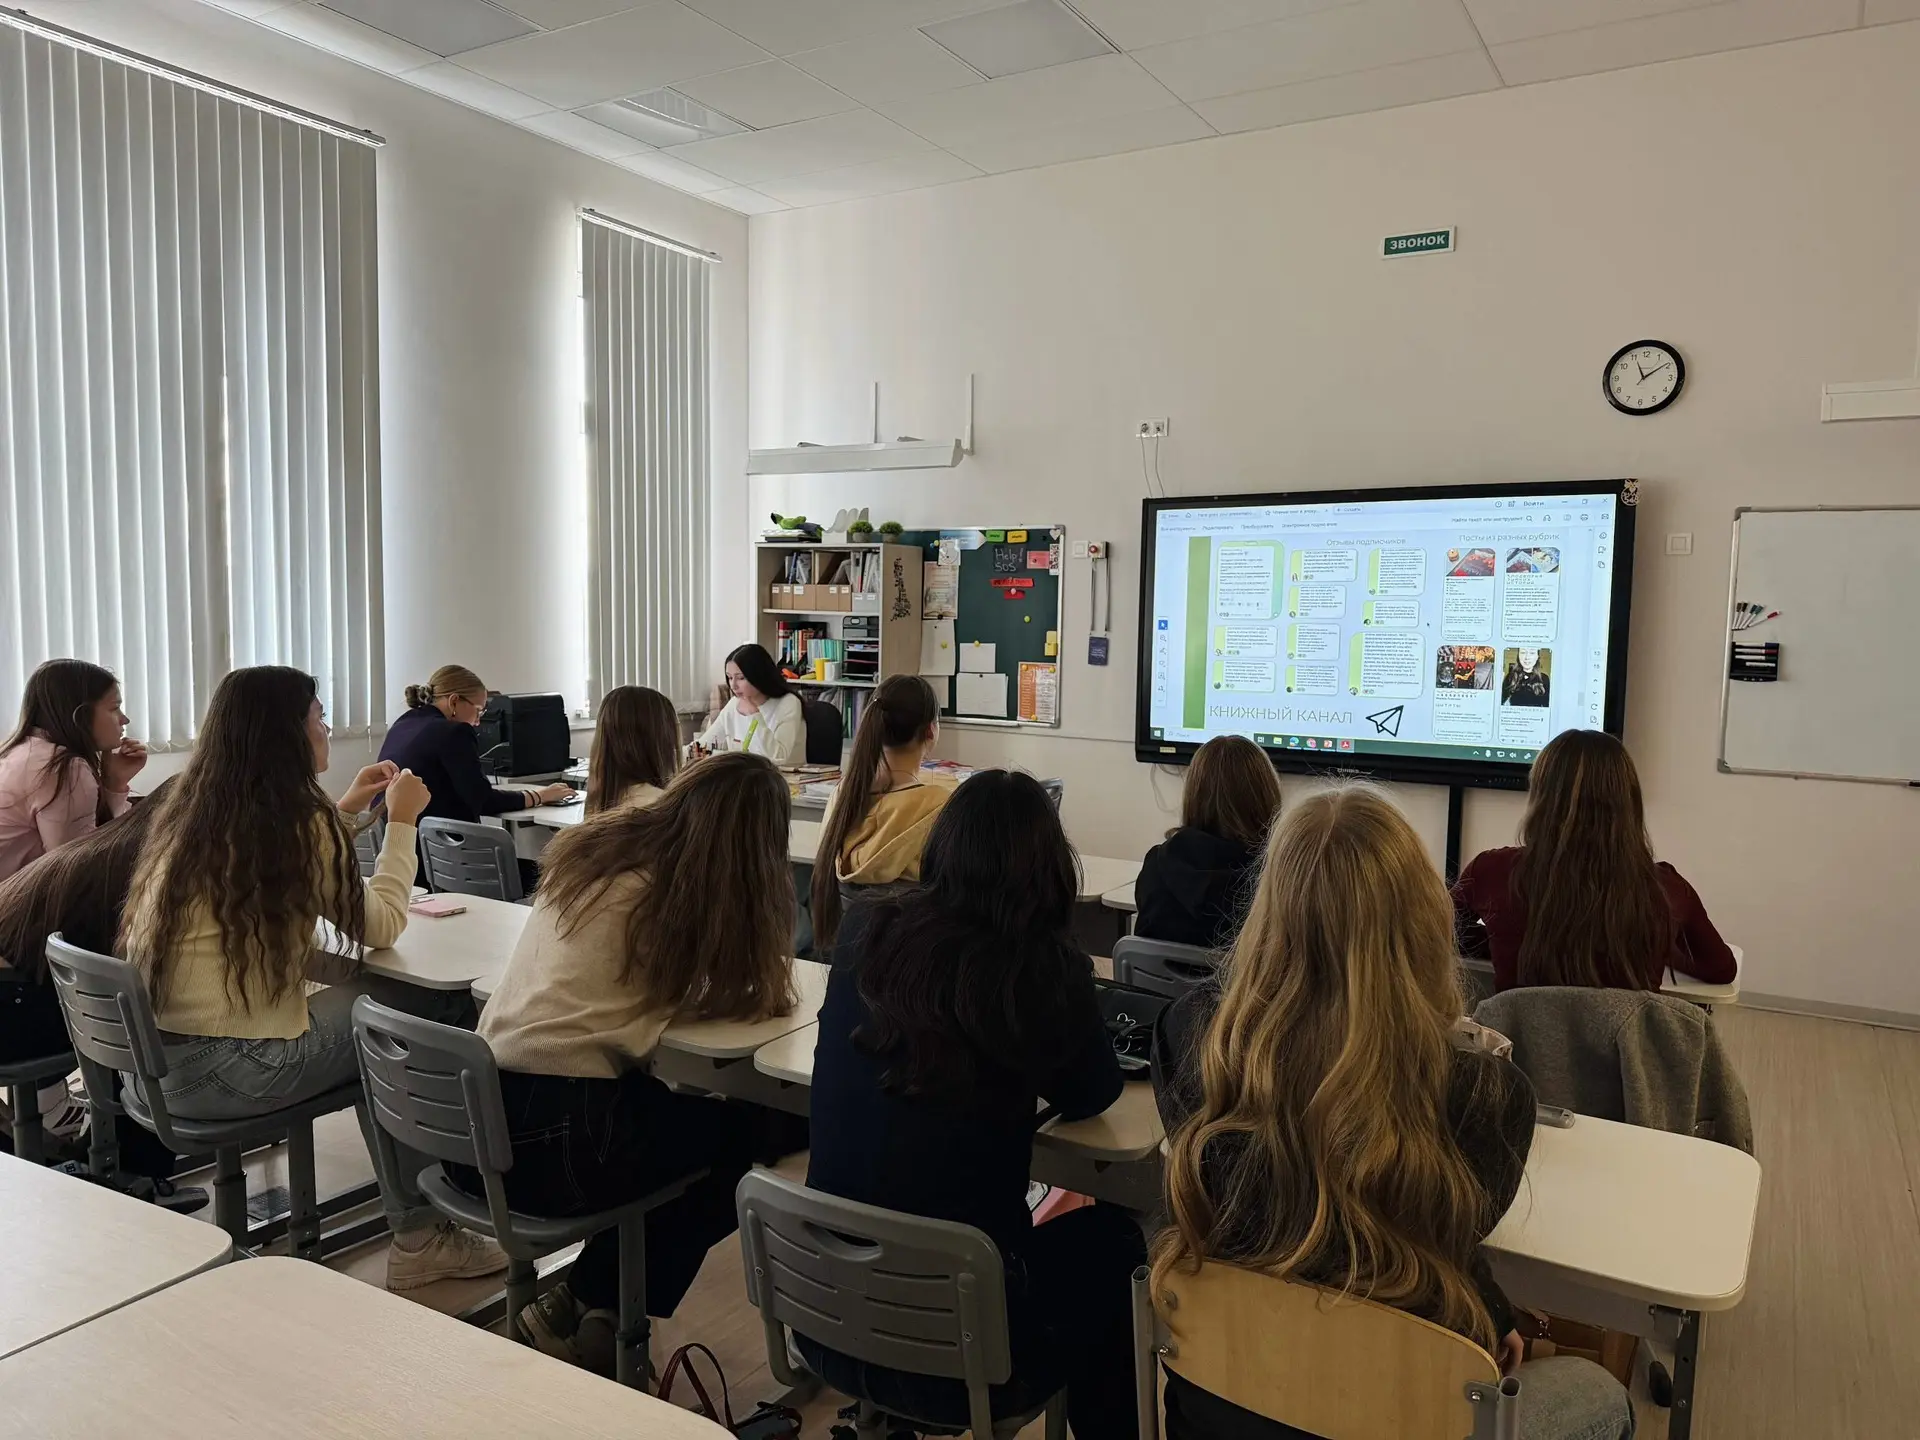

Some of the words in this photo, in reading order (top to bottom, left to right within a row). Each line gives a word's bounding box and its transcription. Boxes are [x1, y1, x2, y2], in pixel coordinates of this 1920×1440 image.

[1390, 235, 1446, 250] ЗВОНОК
[1326, 538, 1355, 546] Отзывы
[1356, 537, 1406, 547] подписчиков
[1459, 534, 1484, 542] Посты
[1497, 533, 1527, 542] разных
[1528, 532, 1560, 542] рубрик
[995, 547, 1024, 562] Help!
[1209, 705, 1292, 721] КНИЖНЫЙ
[1297, 709, 1353, 724] КАНАЛ
